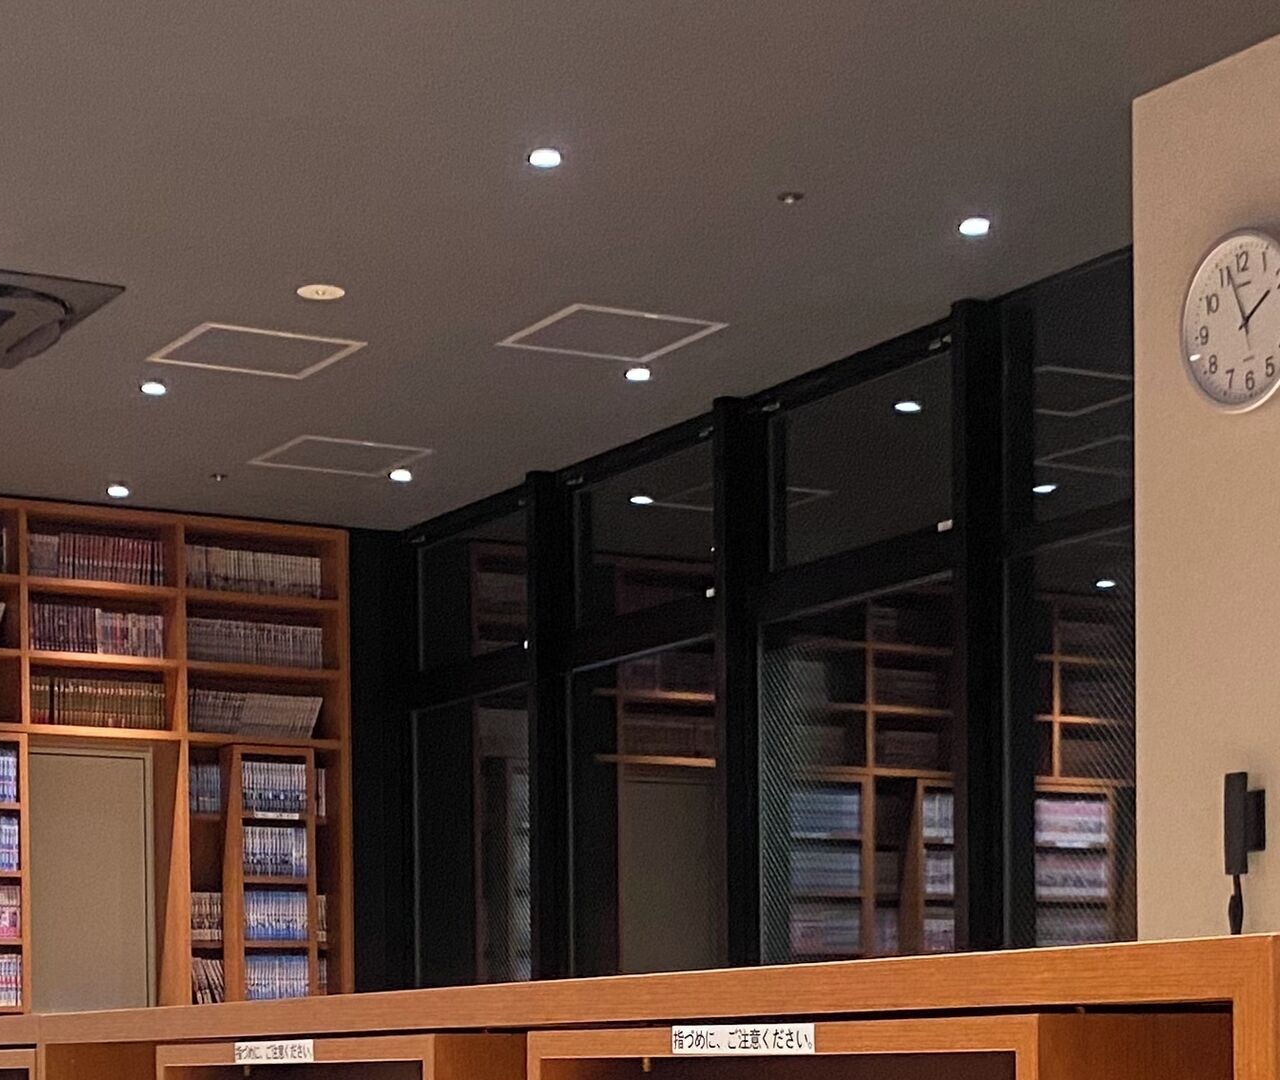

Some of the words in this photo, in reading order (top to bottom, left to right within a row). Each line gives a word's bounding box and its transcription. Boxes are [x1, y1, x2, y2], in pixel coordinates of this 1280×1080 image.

[1235, 250, 1249, 272] 12
[1261, 251, 1267, 272] 1
[1219, 266, 1231, 288] 11
[1205, 293, 1219, 315] 10
[1199, 325, 1209, 346] 9
[1208, 354, 1218, 375] 8
[1265, 355, 1276, 378] 5
[1225, 368, 1235, 389] 7
[1245, 370, 1255, 391] 6
[673, 1028, 813, 1050] 指づめに、ご注意ください。
